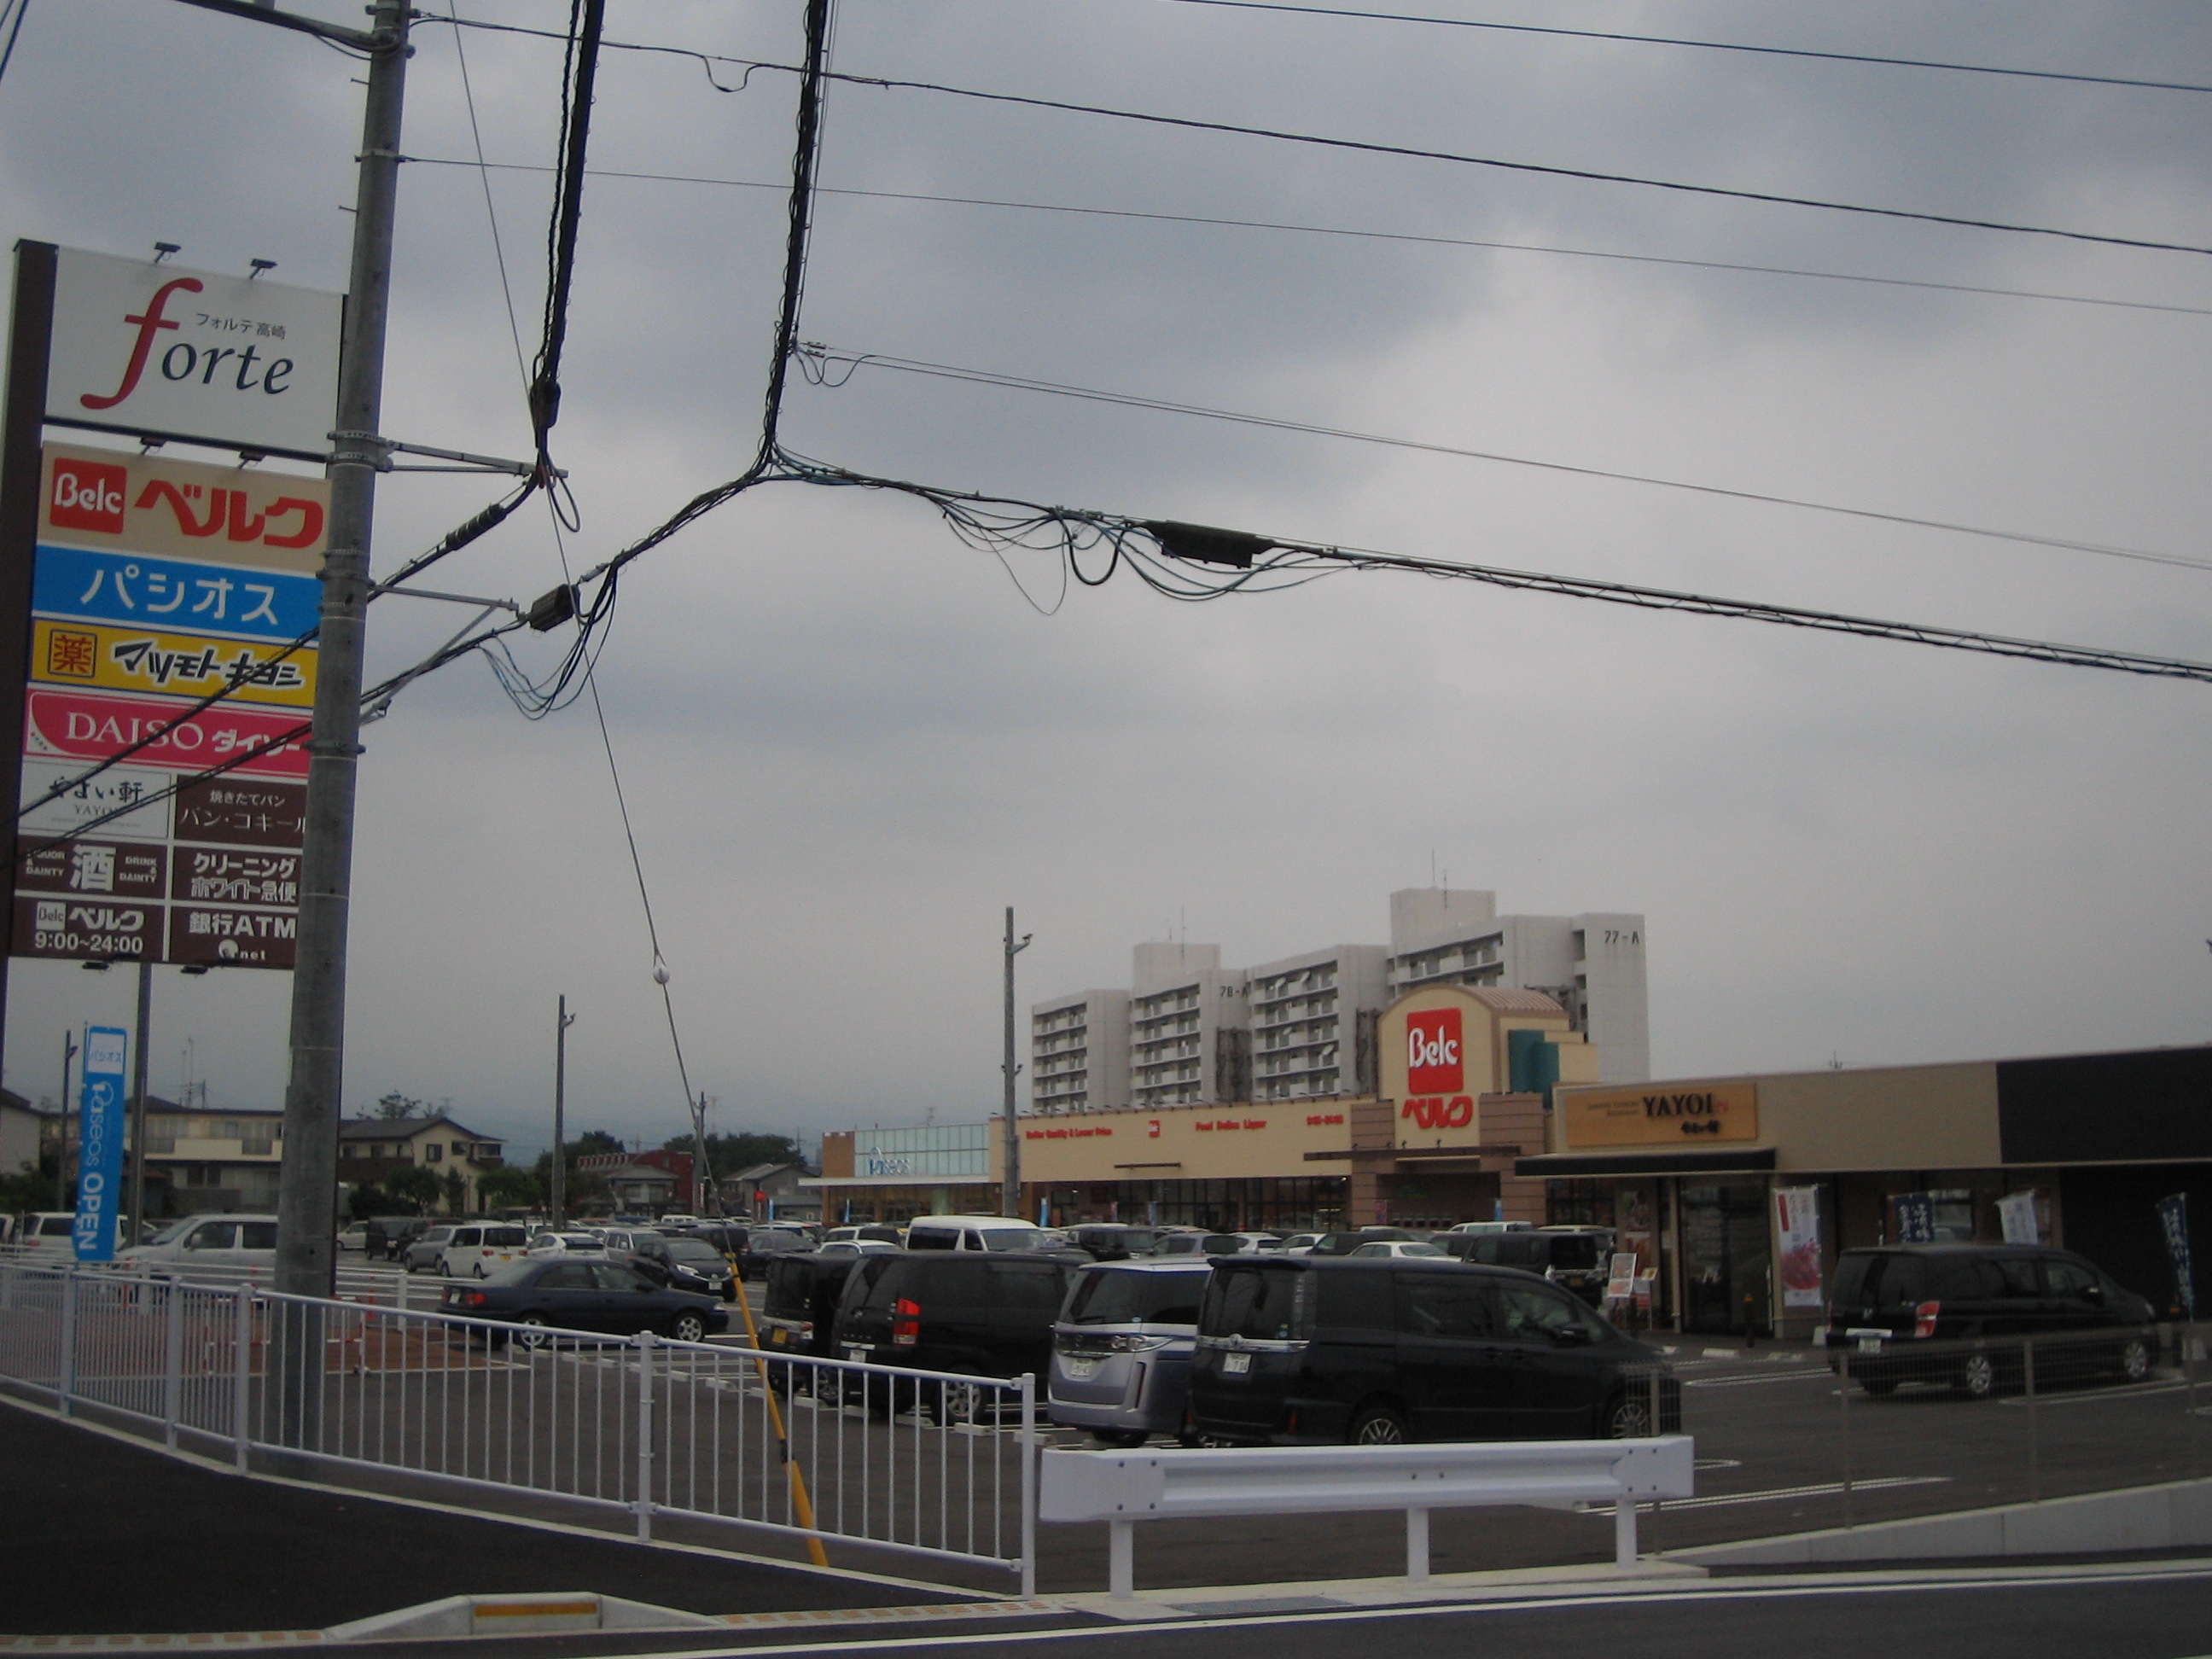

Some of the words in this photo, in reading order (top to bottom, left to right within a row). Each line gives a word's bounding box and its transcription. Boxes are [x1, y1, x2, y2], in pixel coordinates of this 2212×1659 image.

[80, 277, 294, 410] forte
[55, 472, 123, 514] Belc
[134, 478, 325, 549] ベルク
[80, 563, 278, 626] パシオス
[54, 634, 91, 675] 薬
[66, 711, 204, 751] DAISO
[26, 866, 65, 876] DAINTY
[69, 843, 117, 892] 酒
[119, 872, 157, 883] DAINTY
[125, 856, 157, 866] DRINK
[194, 852, 297, 879] クリーニング
[38, 906, 64, 923] Belc
[69, 906, 145, 932] ベルク
[189, 911, 297, 939] 銀行ATM
[1408, 1025, 1459, 1068] Belc
[1401, 1095, 1474, 1129] ベルク
[1642, 1092, 1714, 1117] YAYOI
[79, 1172, 105, 1250] OPEN
